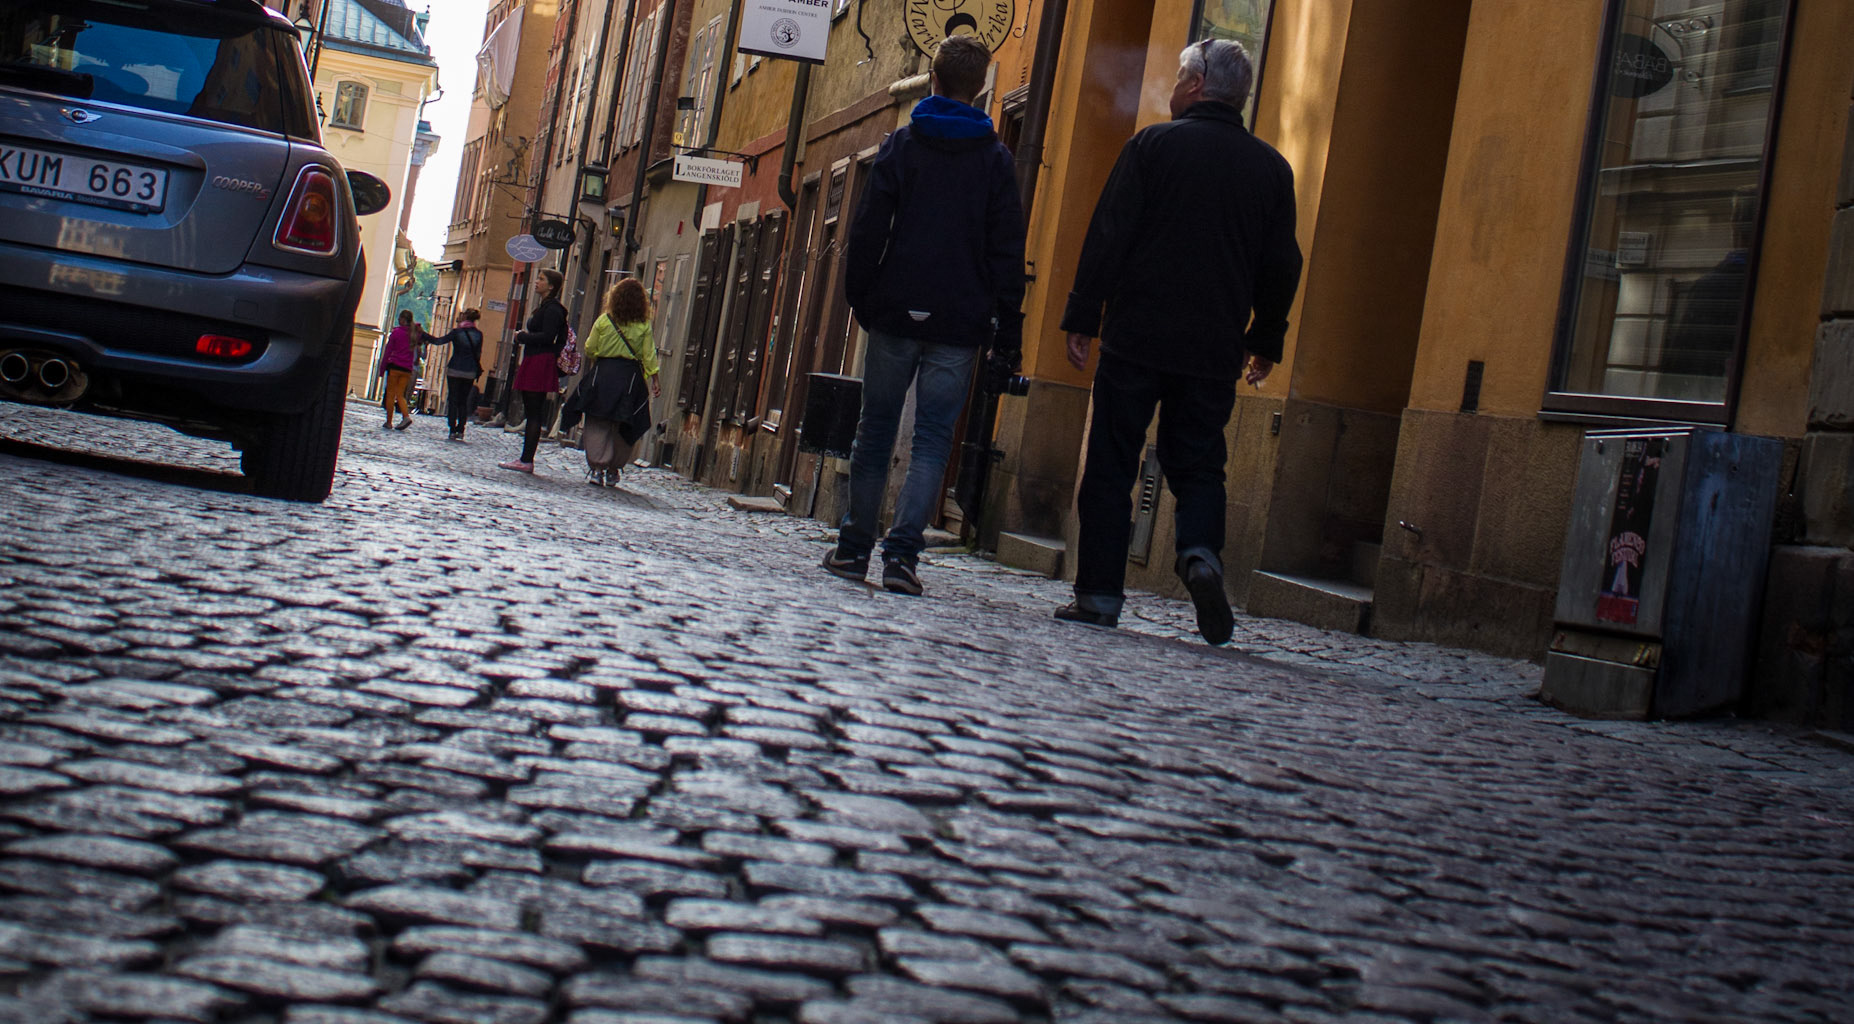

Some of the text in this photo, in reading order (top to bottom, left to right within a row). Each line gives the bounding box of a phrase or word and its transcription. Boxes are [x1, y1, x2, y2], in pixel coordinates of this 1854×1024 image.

[976, 2, 1008, 48] lrika
[0, 149, 157, 200] KUM 663
[687, 164, 740, 176] BOKFÖRLAGET
[212, 175, 262, 192] COOPER
[21, 185, 73, 201] BAVARIA
